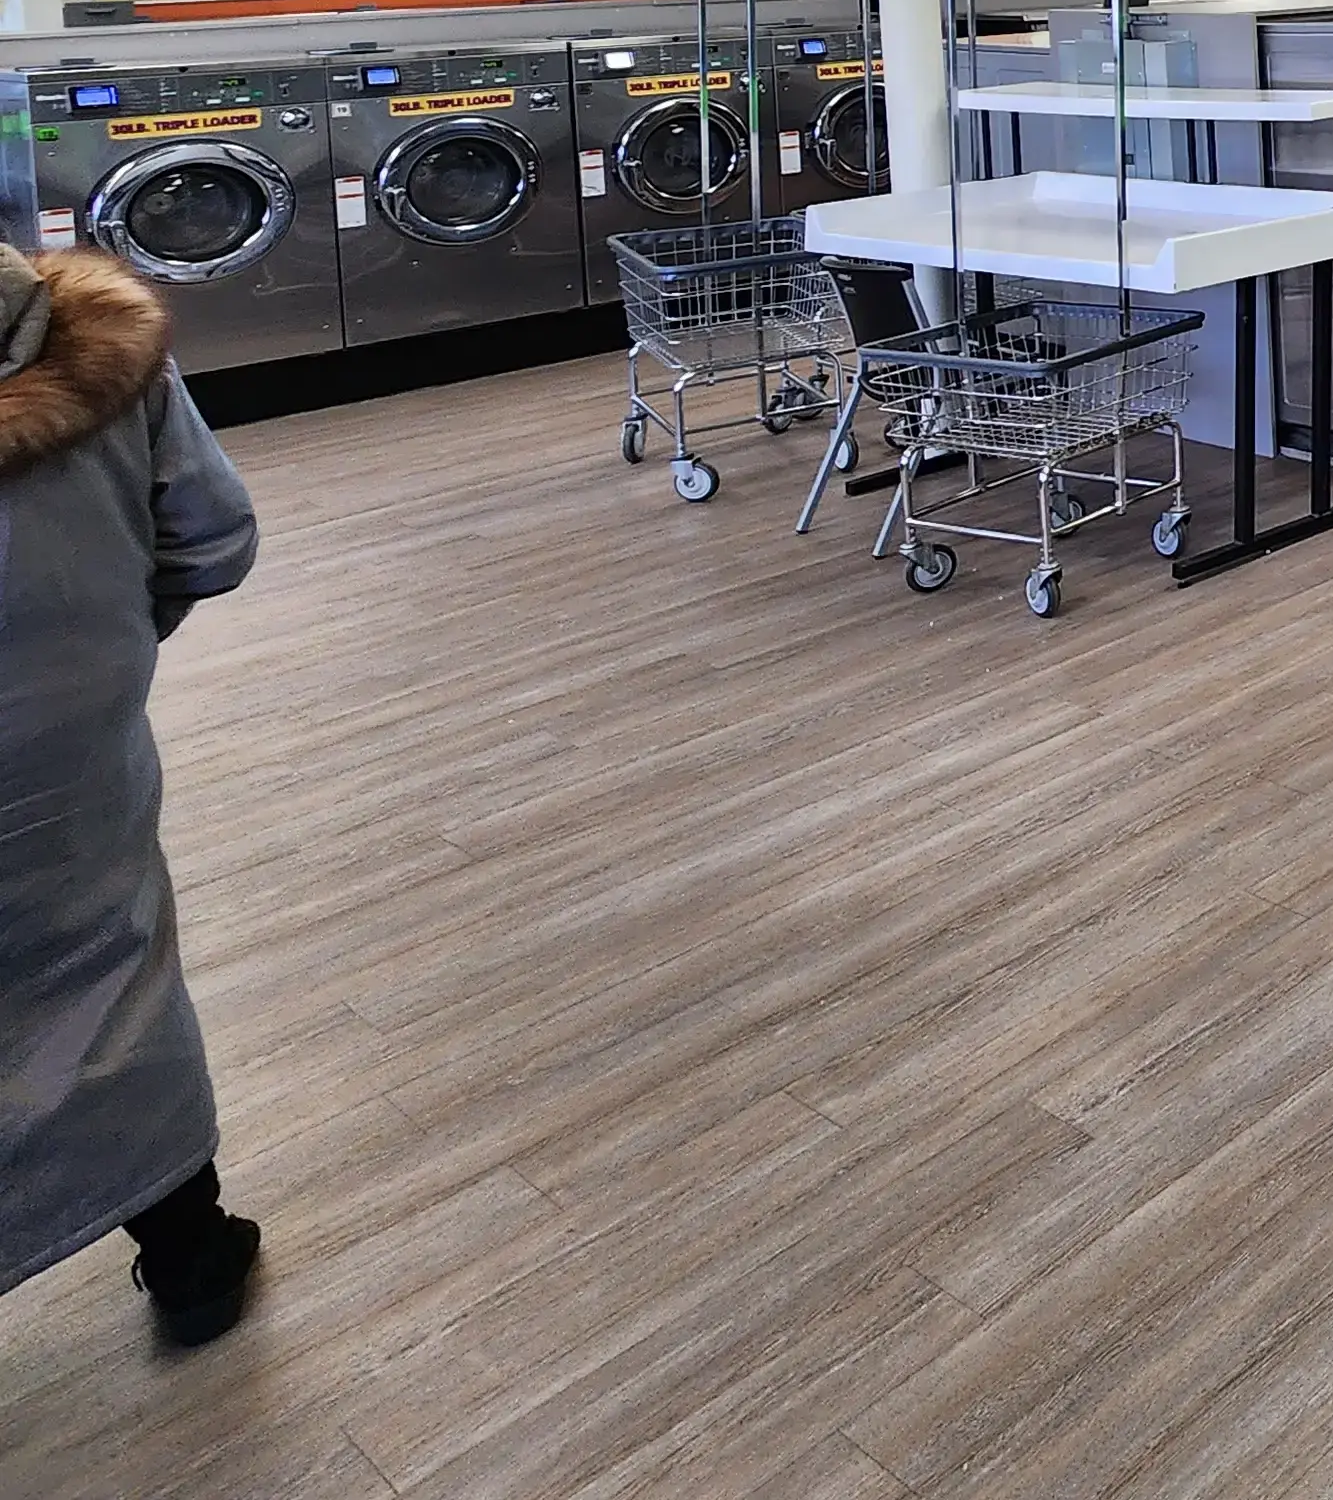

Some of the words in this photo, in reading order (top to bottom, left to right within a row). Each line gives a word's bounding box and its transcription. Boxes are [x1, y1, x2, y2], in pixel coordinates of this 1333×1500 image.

[843, 64, 865, 75] TRIPL
[657, 79, 689, 90] TRIPLE
[690, 76, 728, 87] LODER
[426, 97, 465, 109] TRIPLE
[466, 93, 512, 106] LOADER
[154, 118, 199, 132] TRIPLE
[203, 114, 258, 128] LOADER
